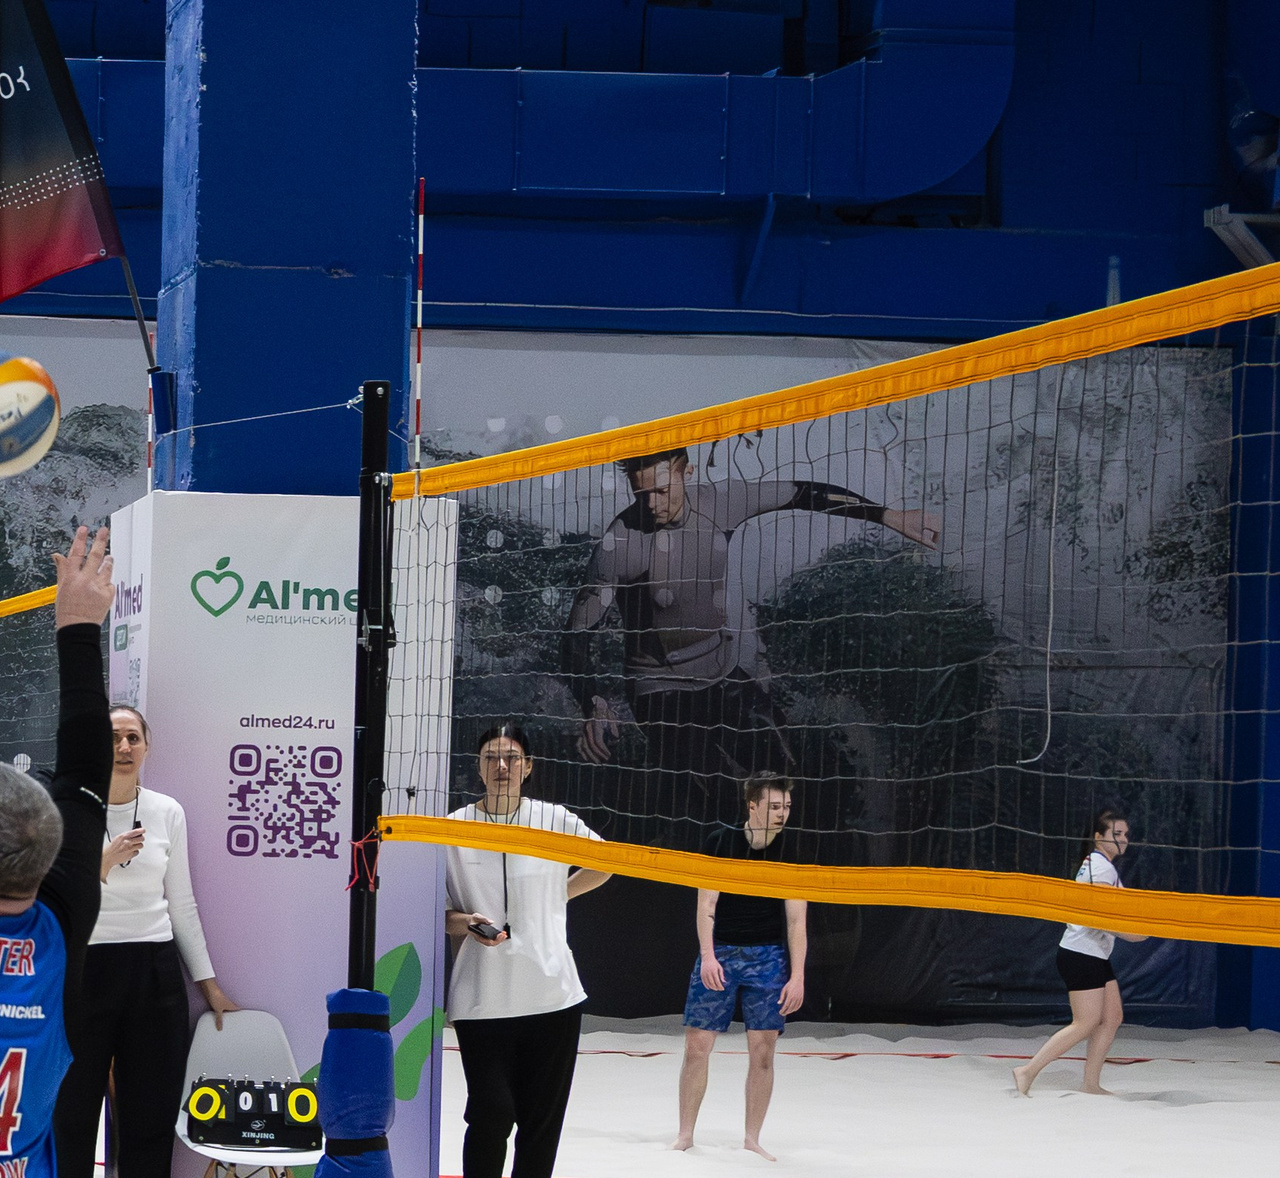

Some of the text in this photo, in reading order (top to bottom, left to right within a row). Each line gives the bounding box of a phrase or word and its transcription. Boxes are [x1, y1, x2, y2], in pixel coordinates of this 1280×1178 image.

[248, 580, 359, 613] Al'me
[246, 614, 346, 627] медицинский
[239, 714, 335, 730] almed24.ru
[242, 1131, 275, 1139] XINJING
